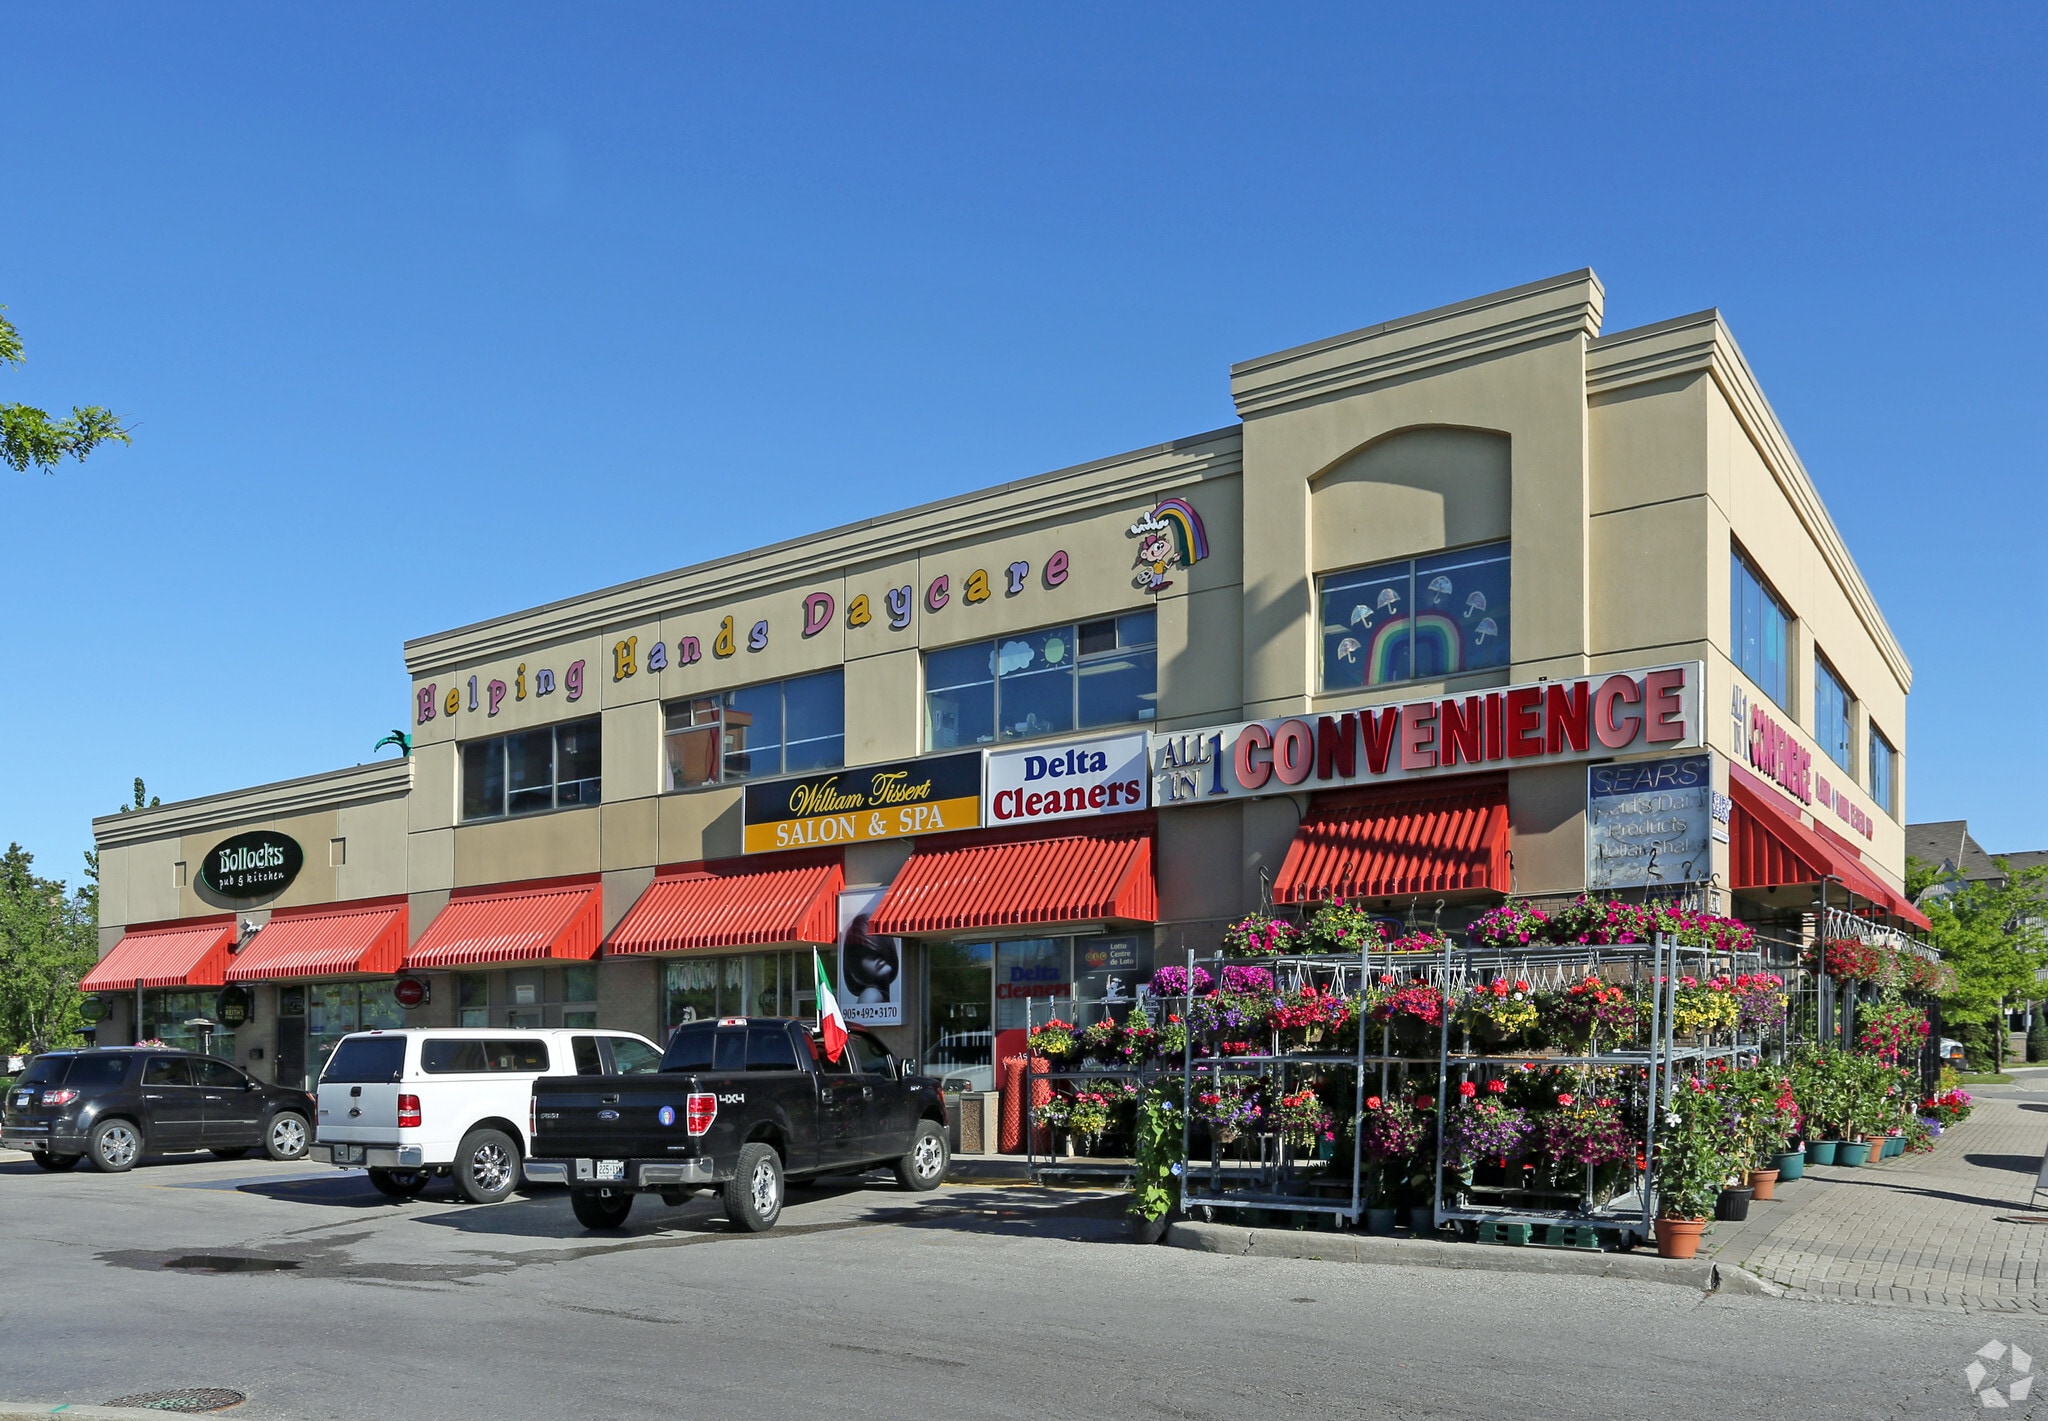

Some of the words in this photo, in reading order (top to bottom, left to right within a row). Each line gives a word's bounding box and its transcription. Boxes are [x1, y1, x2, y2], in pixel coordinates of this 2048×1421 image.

[418, 659, 585, 723] Helping
[614, 615, 768, 679] Hands
[804, 550, 1070, 636] Daycare
[1208, 729, 1228, 796] 1
[1234, 668, 1687, 790] CONVENIENCE
[1024, 748, 1108, 782] Delta
[1161, 732, 1211, 769] ALL
[789, 775, 864, 817] William
[868, 770, 931, 806] Tissert
[1168, 769, 1200, 801] IN
[1594, 761, 1699, 793] SEARS
[993, 777, 1140, 821] Cleaners
[776, 813, 855, 848] SALON
[868, 812, 887, 836] &
[899, 804, 944, 833] SPA
[1608, 816, 1687, 838] Products
[219, 875, 234, 890] pub
[247, 871, 284, 883] kitchen
[1010, 964, 1060, 982] Delta
[996, 982, 1071, 999] Cleaners
